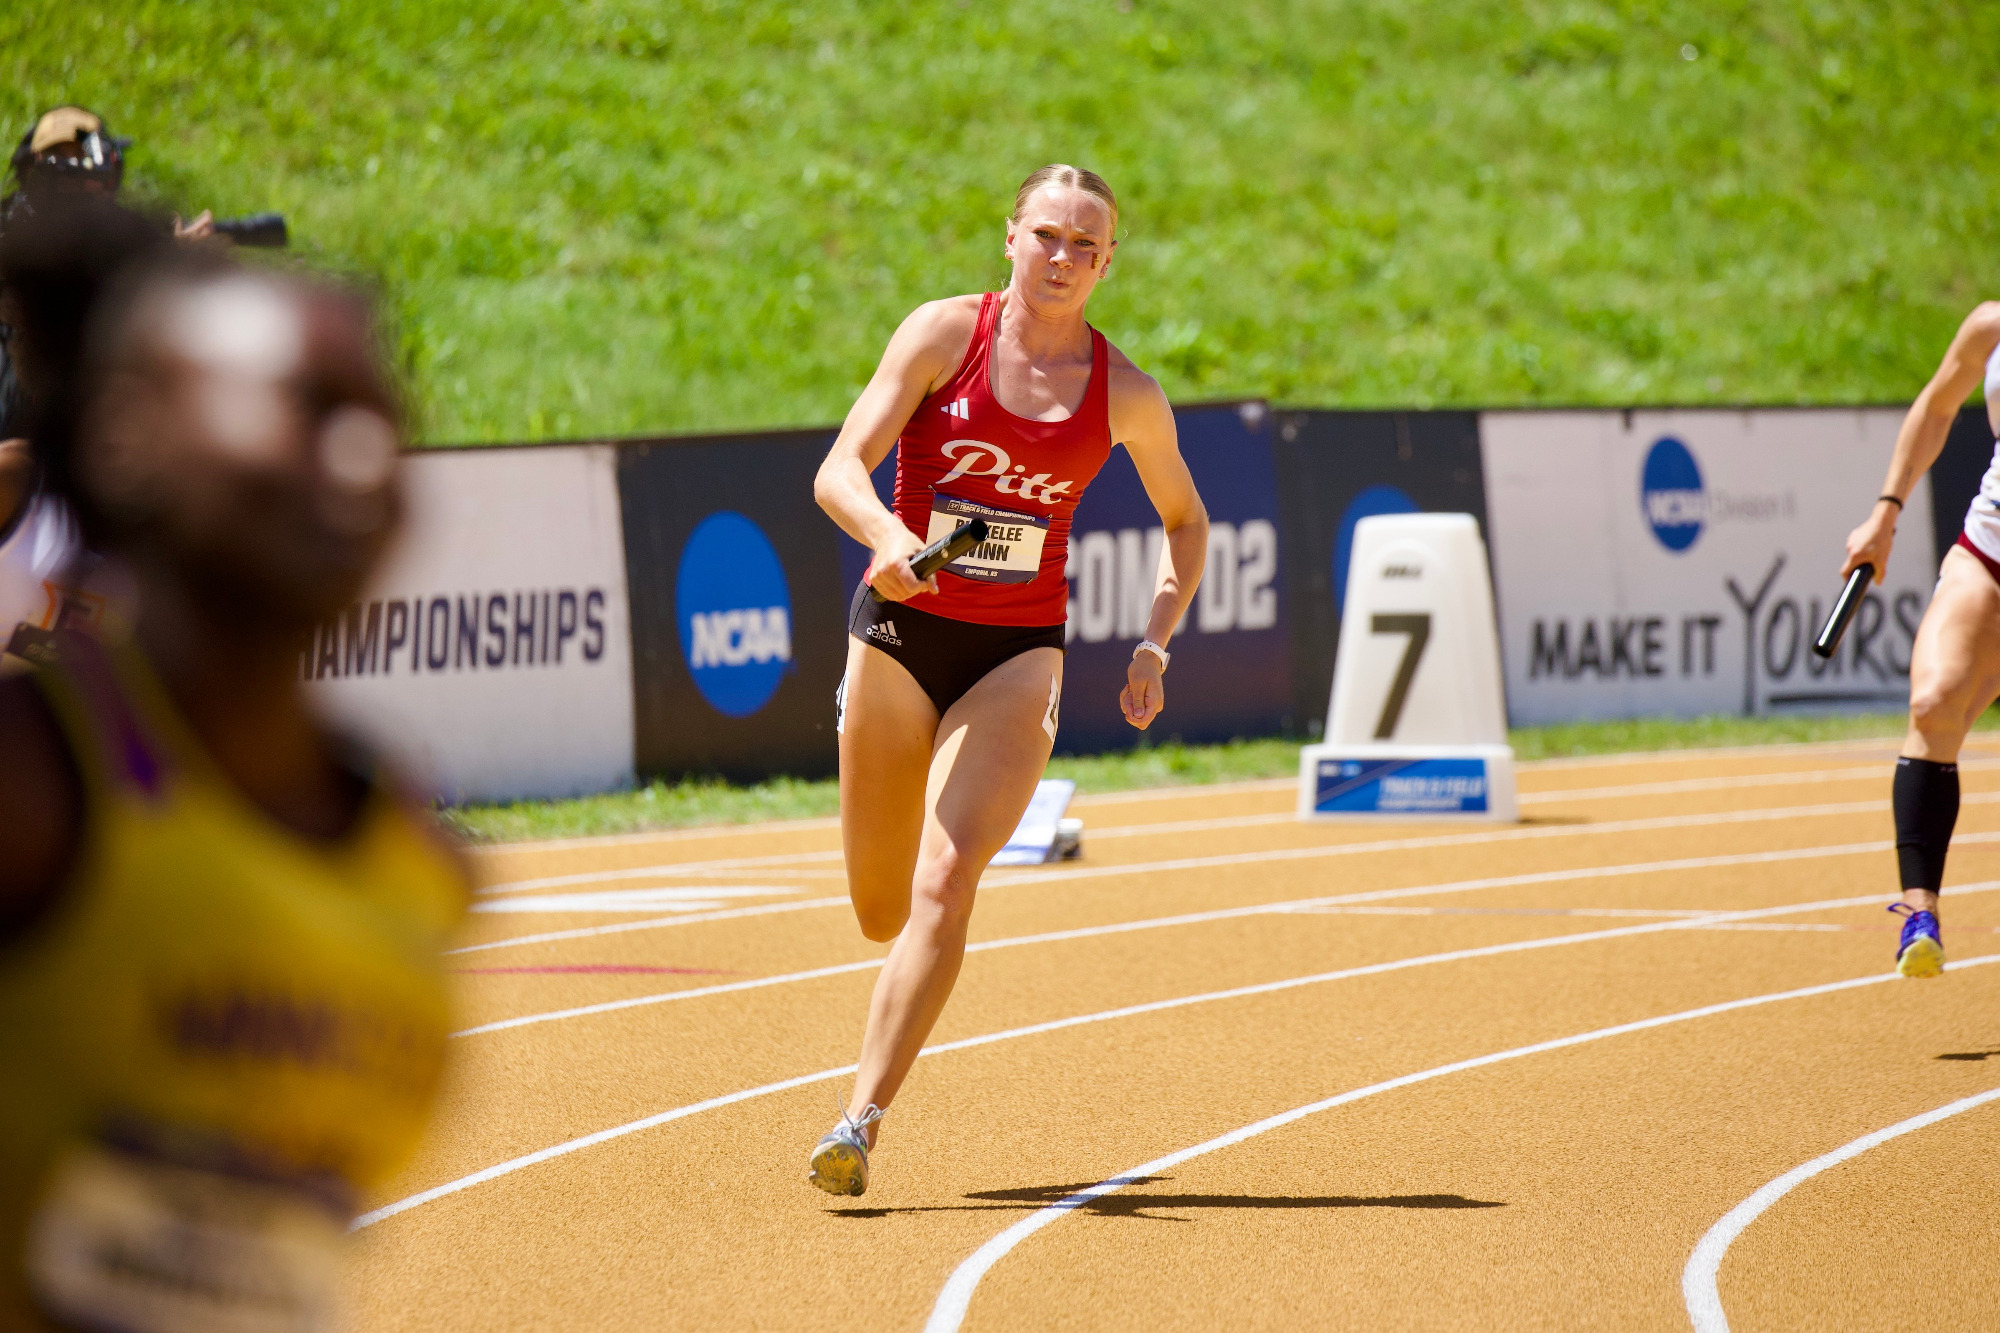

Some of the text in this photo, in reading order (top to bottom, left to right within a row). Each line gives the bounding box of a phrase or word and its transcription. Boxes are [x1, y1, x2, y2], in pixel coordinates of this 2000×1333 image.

[935, 439, 1074, 505] Pitt
[965, 568, 989, 576] EMPORIA,
[690, 605, 793, 670] NCAA
[866, 627, 903, 647] adidas
[1530, 616, 1664, 680] MAKE
[1681, 615, 1721, 676] IT
[1370, 612, 1432, 741] 7
